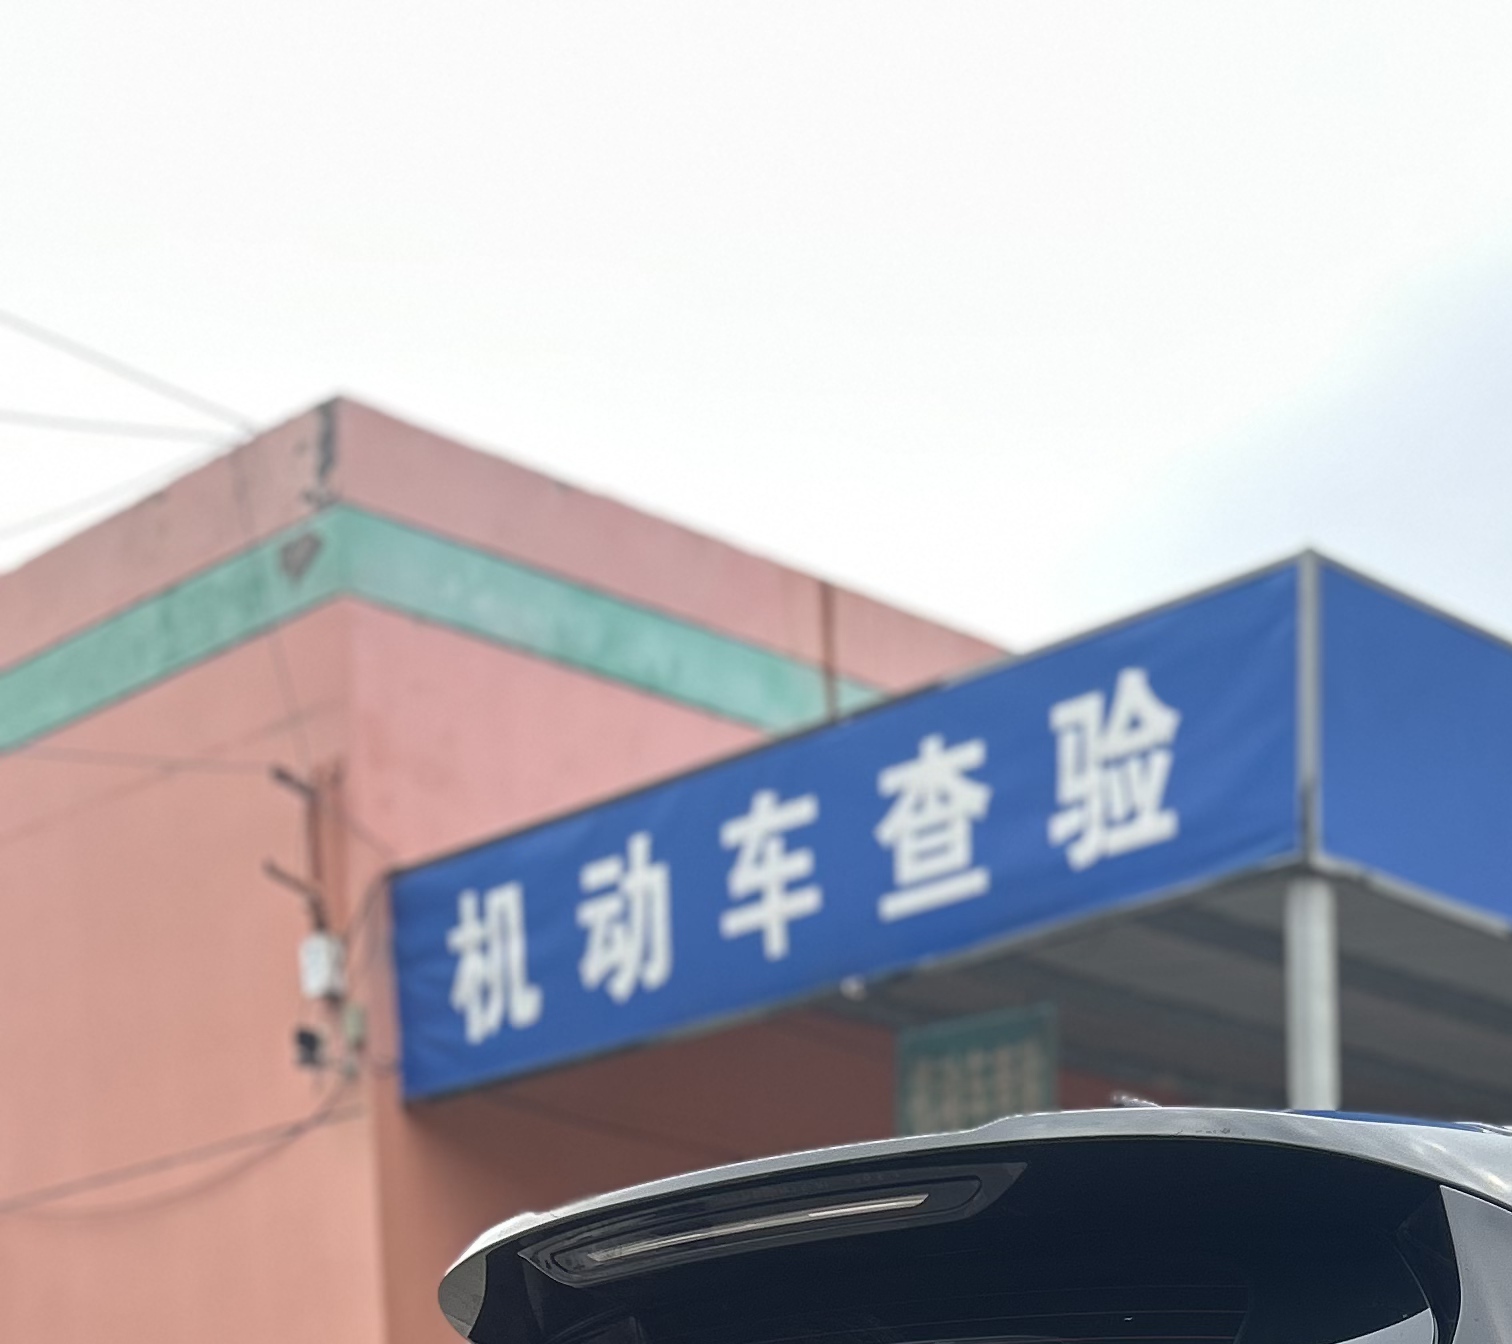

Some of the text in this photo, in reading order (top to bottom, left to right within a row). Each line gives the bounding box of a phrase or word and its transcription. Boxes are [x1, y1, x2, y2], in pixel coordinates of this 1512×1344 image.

[445, 668, 1181, 1044] 机动车查验
